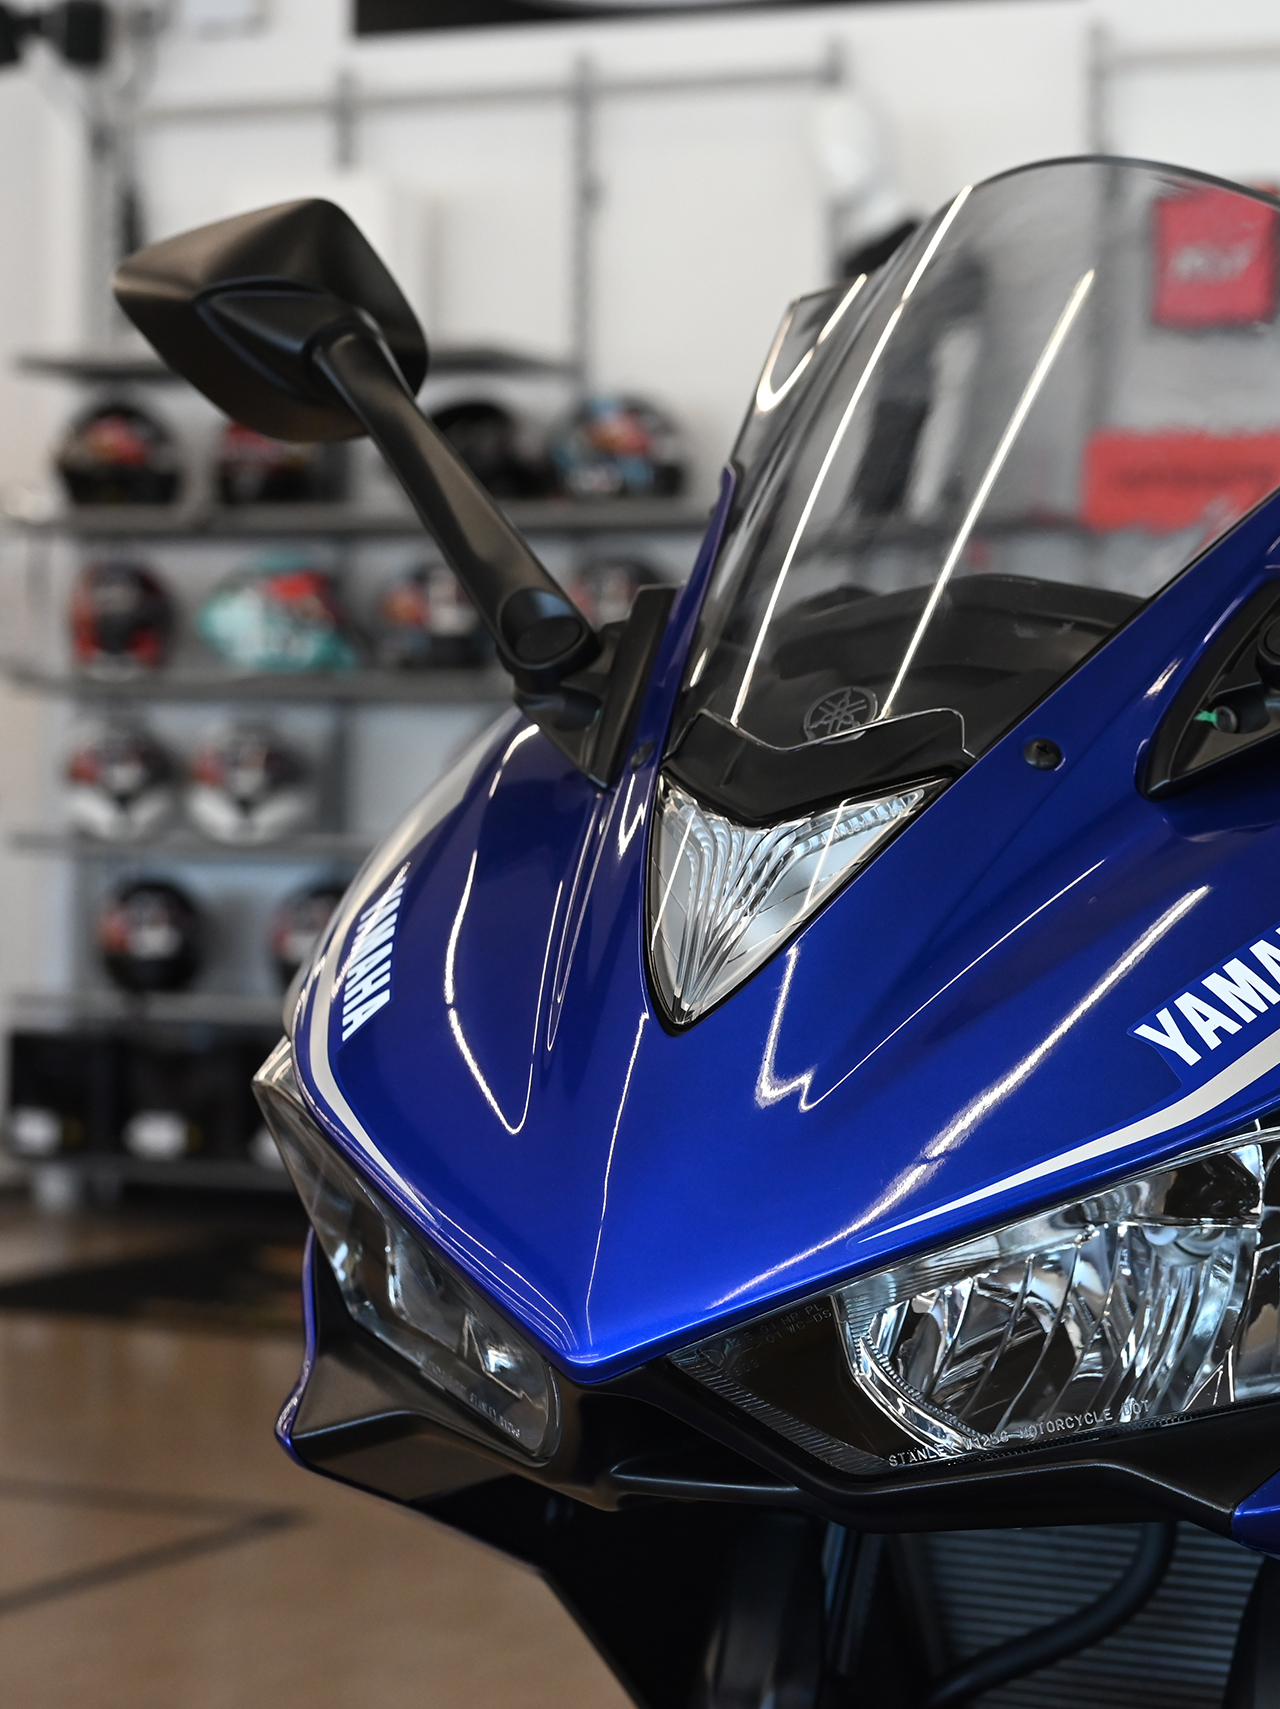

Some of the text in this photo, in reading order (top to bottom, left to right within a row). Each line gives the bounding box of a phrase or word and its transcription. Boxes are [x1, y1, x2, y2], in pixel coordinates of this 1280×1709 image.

[342, 875, 407, 1043] YAMAHA
[781, 1311, 799, 1326] HR
[804, 1303, 824, 1316] PL
[888, 1439, 956, 1468] STANLEY
[1018, 1407, 1114, 1440] MOTORCYCLE
[1120, 1399, 1150, 1417] DOT
